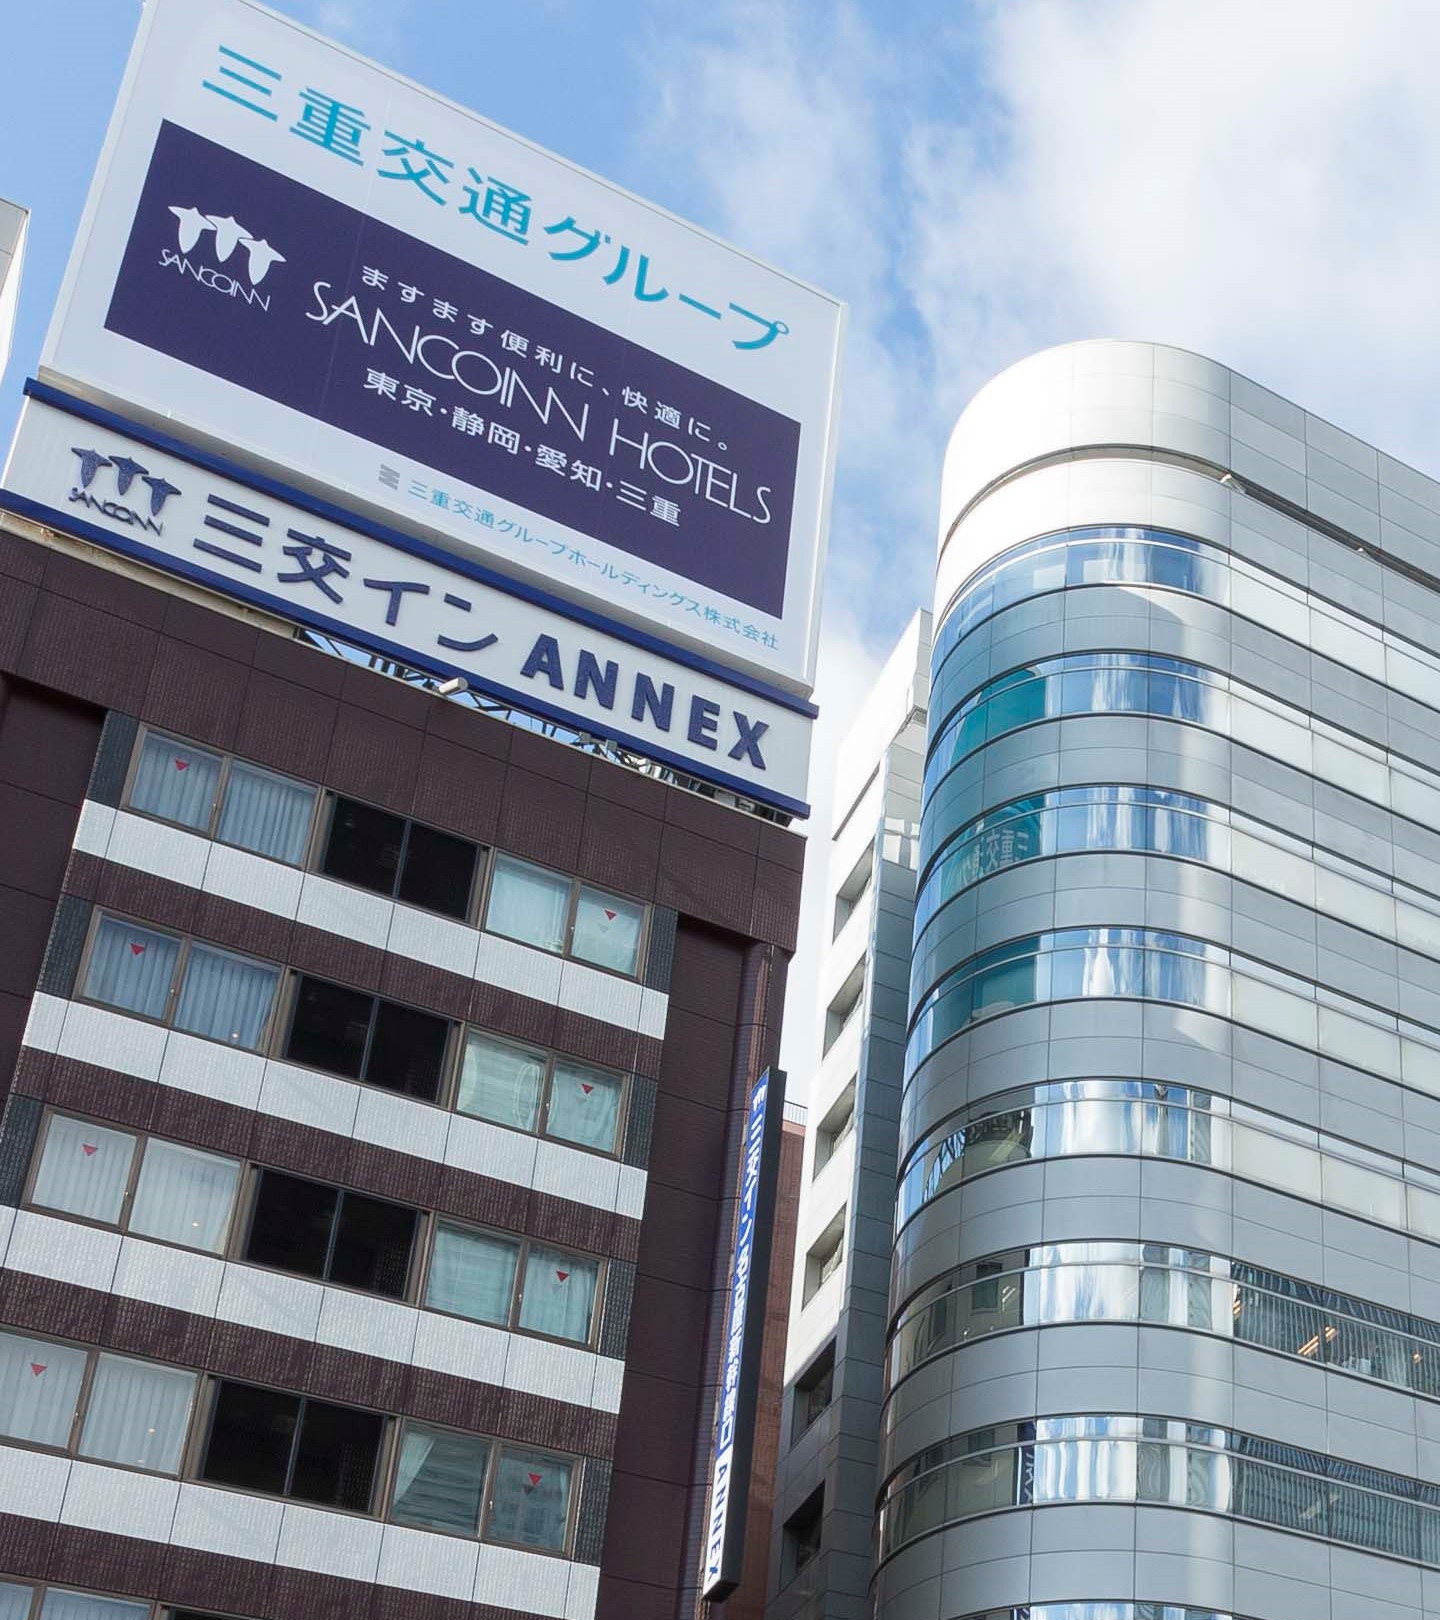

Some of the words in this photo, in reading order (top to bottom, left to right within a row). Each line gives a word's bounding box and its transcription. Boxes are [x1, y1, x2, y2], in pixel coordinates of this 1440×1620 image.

[158, 246, 271, 313] SANCOINN
[201, 44, 791, 352] 三重交通グループ
[306, 279, 588, 445] SANCOINN
[609, 412, 773, 526] HOTELS
[361, 264, 732, 454] ますます便利に、快適に。
[363, 369, 683, 528] 東京・静岡・愛知・三重
[192, 492, 500, 654] 三交イン
[522, 632, 773, 771] ANNEX
[409, 479, 781, 651] 三重交通グループホールディングス株式会社
